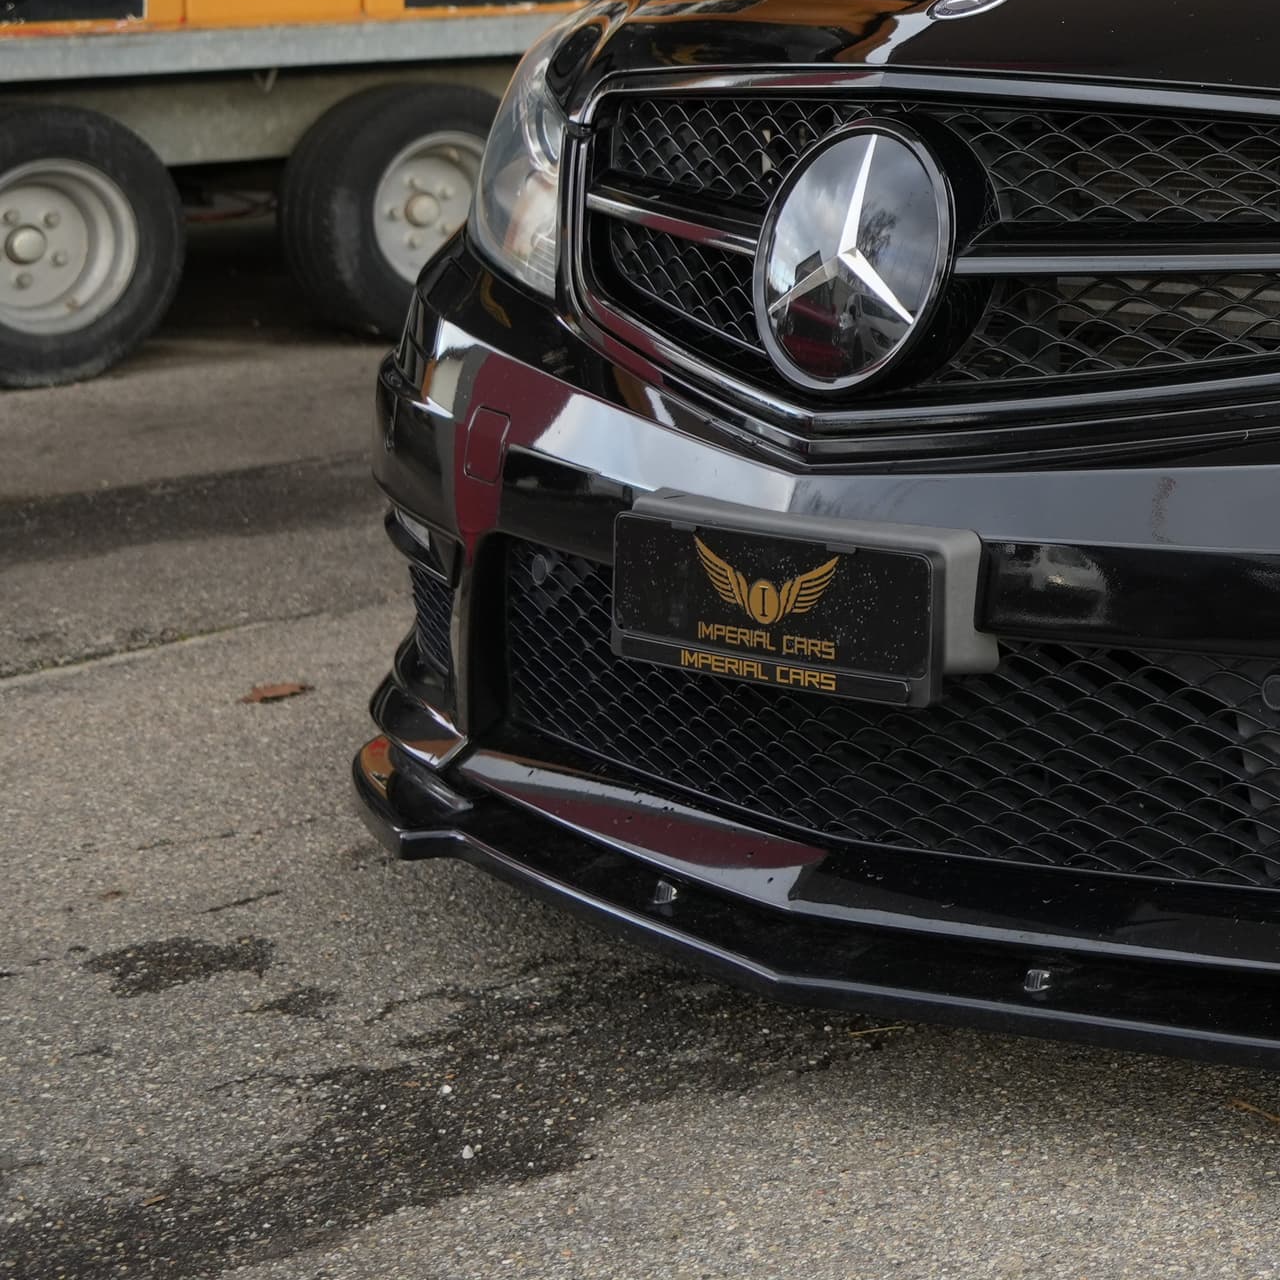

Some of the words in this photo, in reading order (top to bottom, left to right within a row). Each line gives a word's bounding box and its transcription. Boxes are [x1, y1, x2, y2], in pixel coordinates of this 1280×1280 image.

[698, 621, 776, 651] IMPERIAL
[782, 634, 836, 660] CARS
[680, 649, 769, 681] IMPERIAL
[776, 665, 837, 691] CARS
